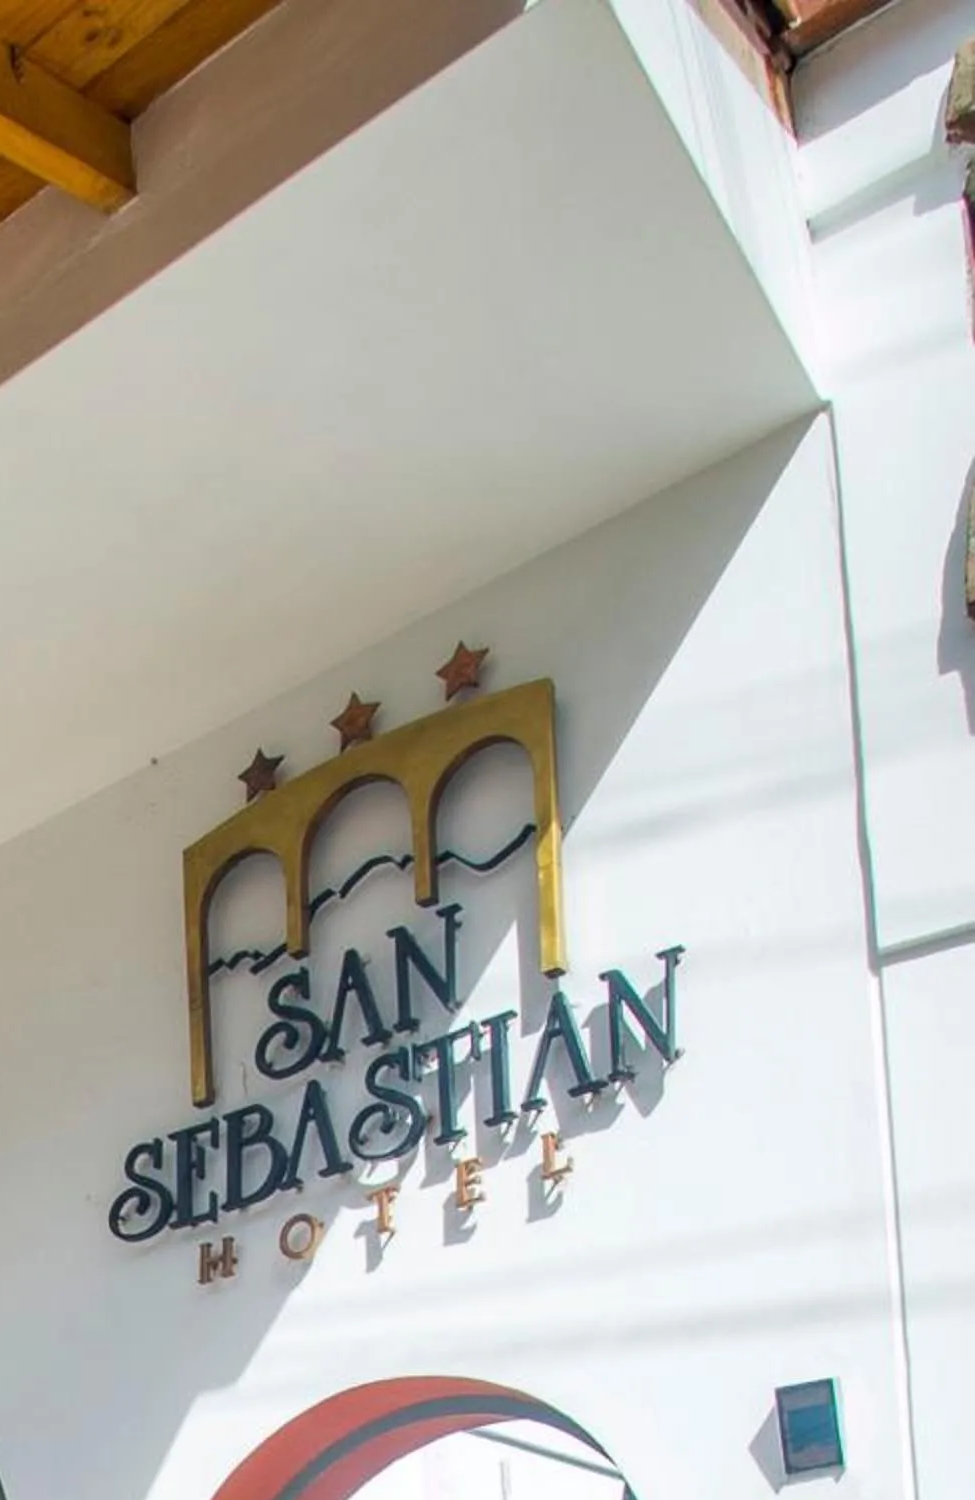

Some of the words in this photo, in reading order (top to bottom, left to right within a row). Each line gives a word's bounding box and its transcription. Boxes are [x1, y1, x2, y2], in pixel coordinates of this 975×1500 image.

[254, 903, 464, 1080] SAN
[108, 944, 687, 1243] SEBASTIAN
[197, 1130, 575, 1285] HOTEL
